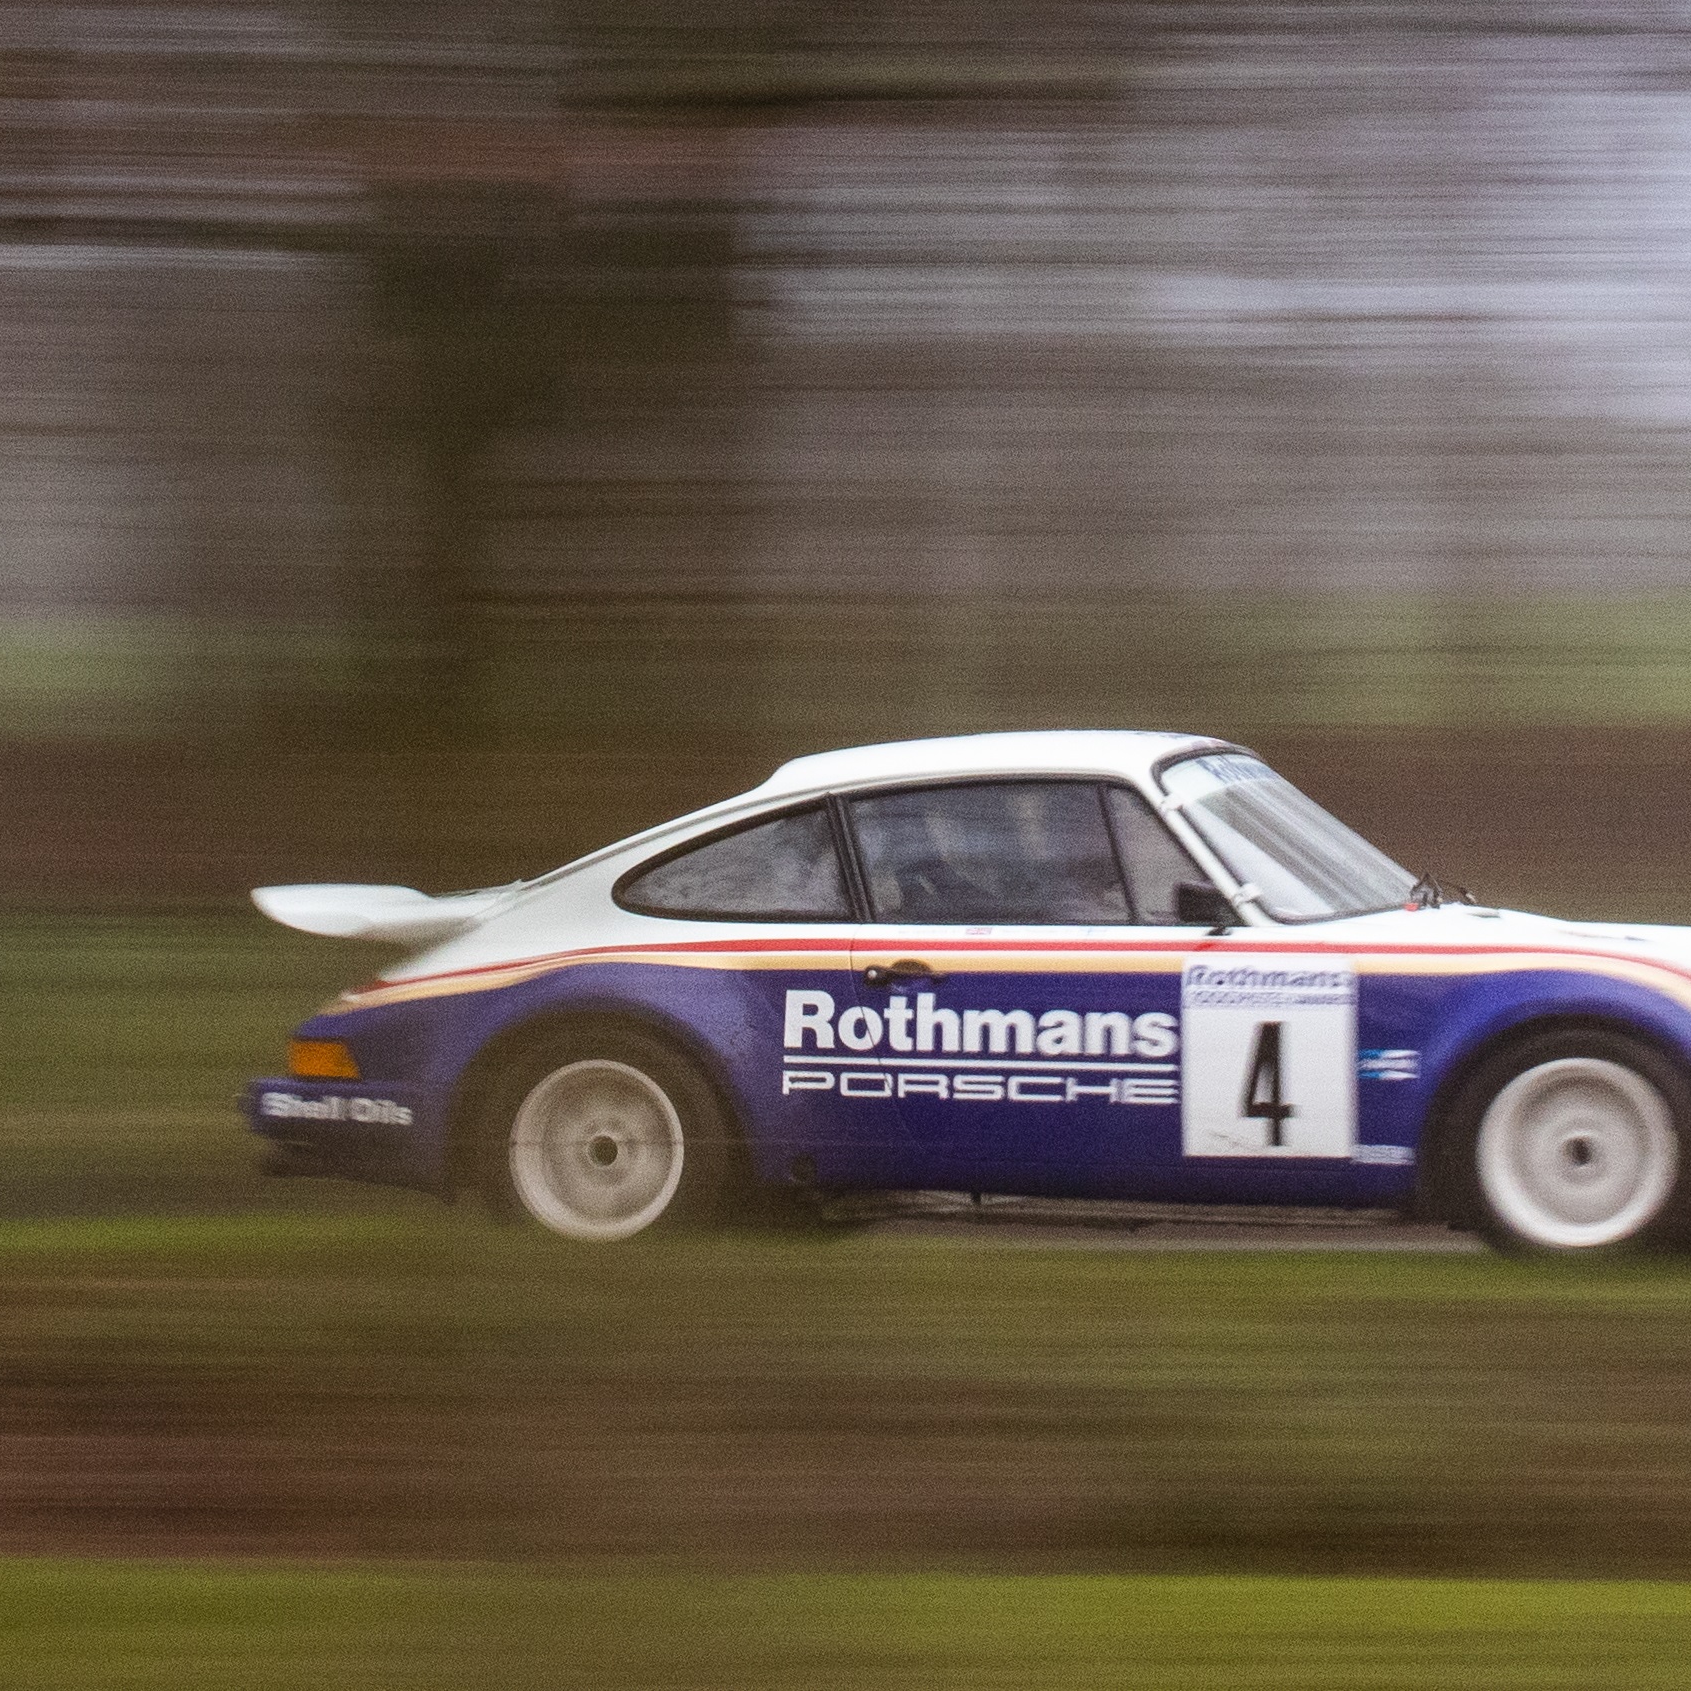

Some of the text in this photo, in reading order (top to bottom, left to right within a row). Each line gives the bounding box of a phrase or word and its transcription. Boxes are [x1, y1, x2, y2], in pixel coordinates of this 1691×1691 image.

[1187, 965, 1354, 987] Rothmans
[783, 989, 1179, 1057] Rothmans
[782, 1069, 1179, 1105] PORSCHE
[1241, 1021, 1297, 1146] 4
